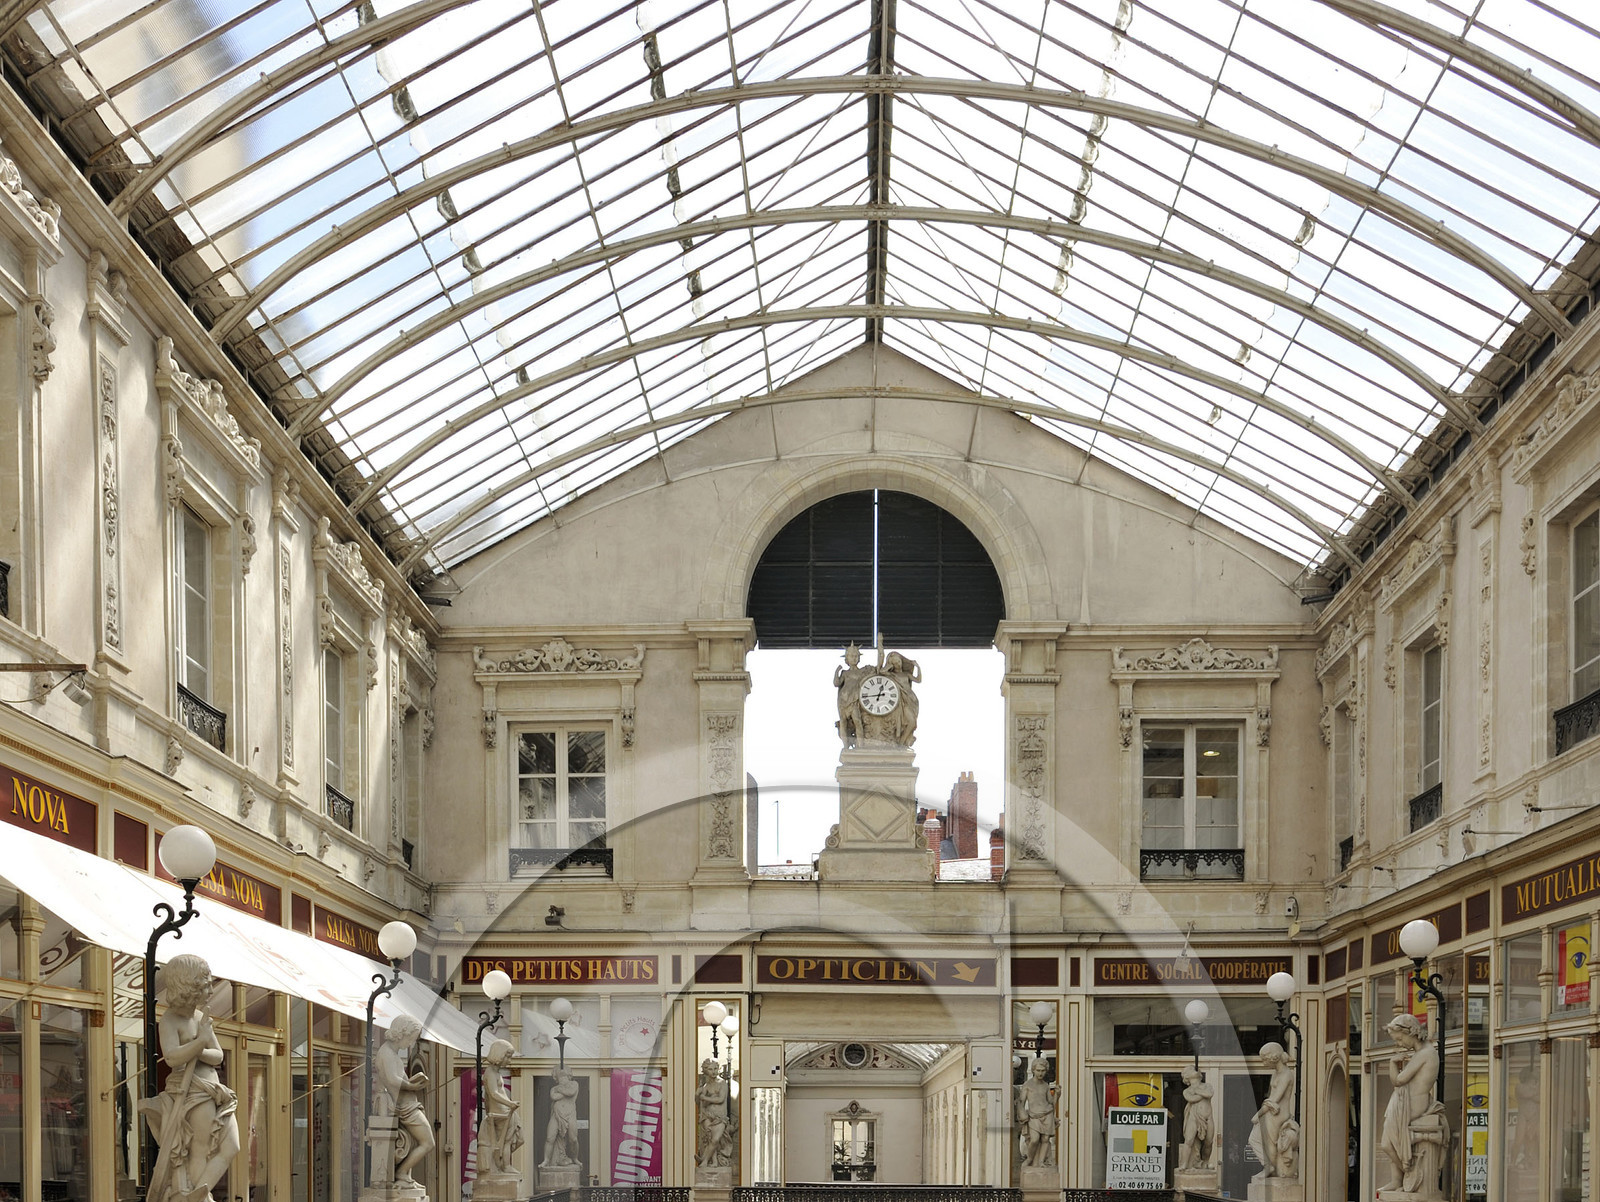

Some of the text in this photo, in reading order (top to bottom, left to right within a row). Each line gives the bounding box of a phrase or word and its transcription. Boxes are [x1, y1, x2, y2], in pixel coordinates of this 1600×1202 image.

[11, 776, 70, 835] NOVA
[230, 871, 264, 911] NOVA
[326, 914, 356, 948] SALSA
[358, 927, 379, 956] NOVA
[467, 958, 654, 981] DES PETITS HAUTS
[768, 957, 939, 982] OPTICIEN
[1101, 962, 1149, 981] CENTRE
[1116, 1111, 1159, 1125] LOUÉ PAR
[1111, 1155, 1162, 1164] CABINET
[1111, 1163, 1162, 1173] PIRAUD
[1118, 1181, 1127, 1189] 02
[1127, 1181, 1136, 1189] 40
[1136, 1181, 1145, 1189] 69
[1146, 1182, 1154, 1190] 75
[1155, 1182, 1164, 1190] 69
